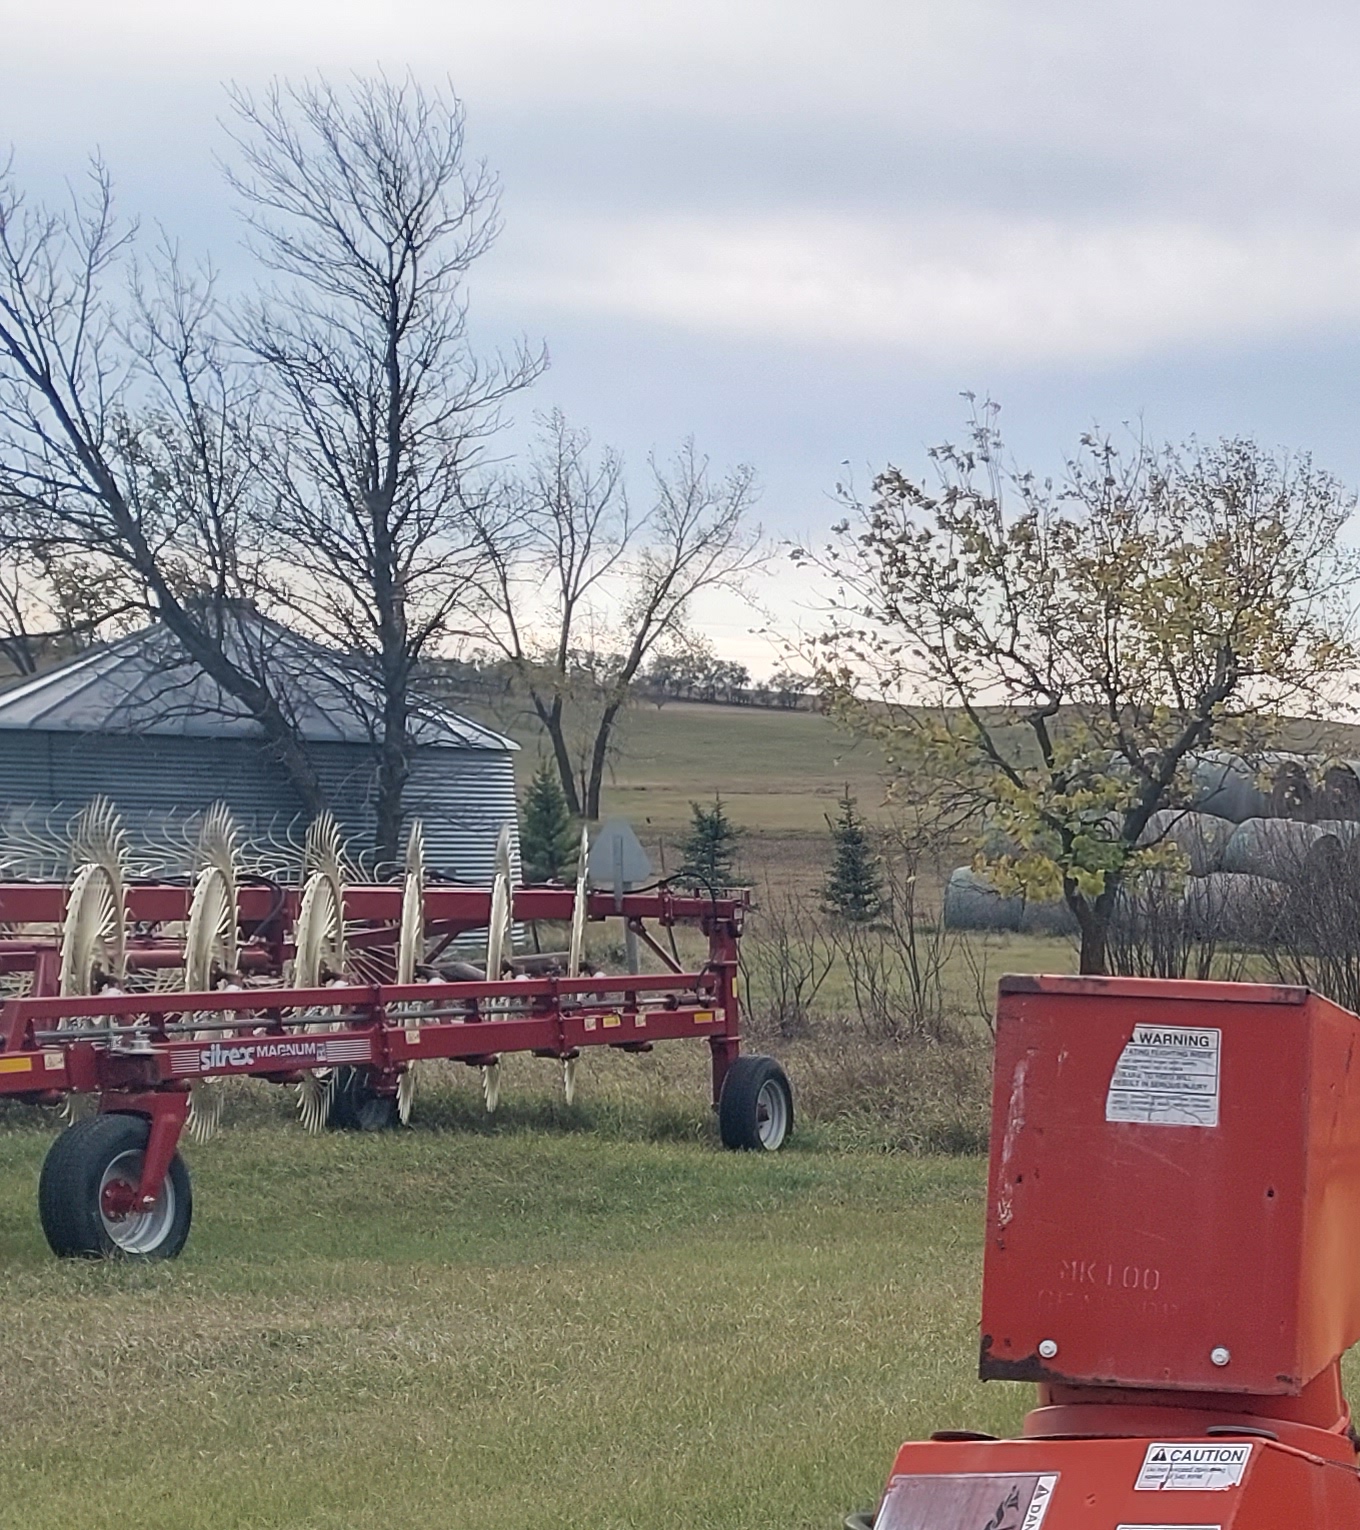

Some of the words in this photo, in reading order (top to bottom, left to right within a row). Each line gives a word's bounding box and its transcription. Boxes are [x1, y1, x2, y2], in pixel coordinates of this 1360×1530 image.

[1140, 1032, 1210, 1047] WARNING
[200, 1043, 255, 1071] sitrex
[257, 1042, 316, 1057] MAGNUM
[1125, 1048, 1149, 1056] TATING
[1170, 1449, 1244, 1462] CAUTION
